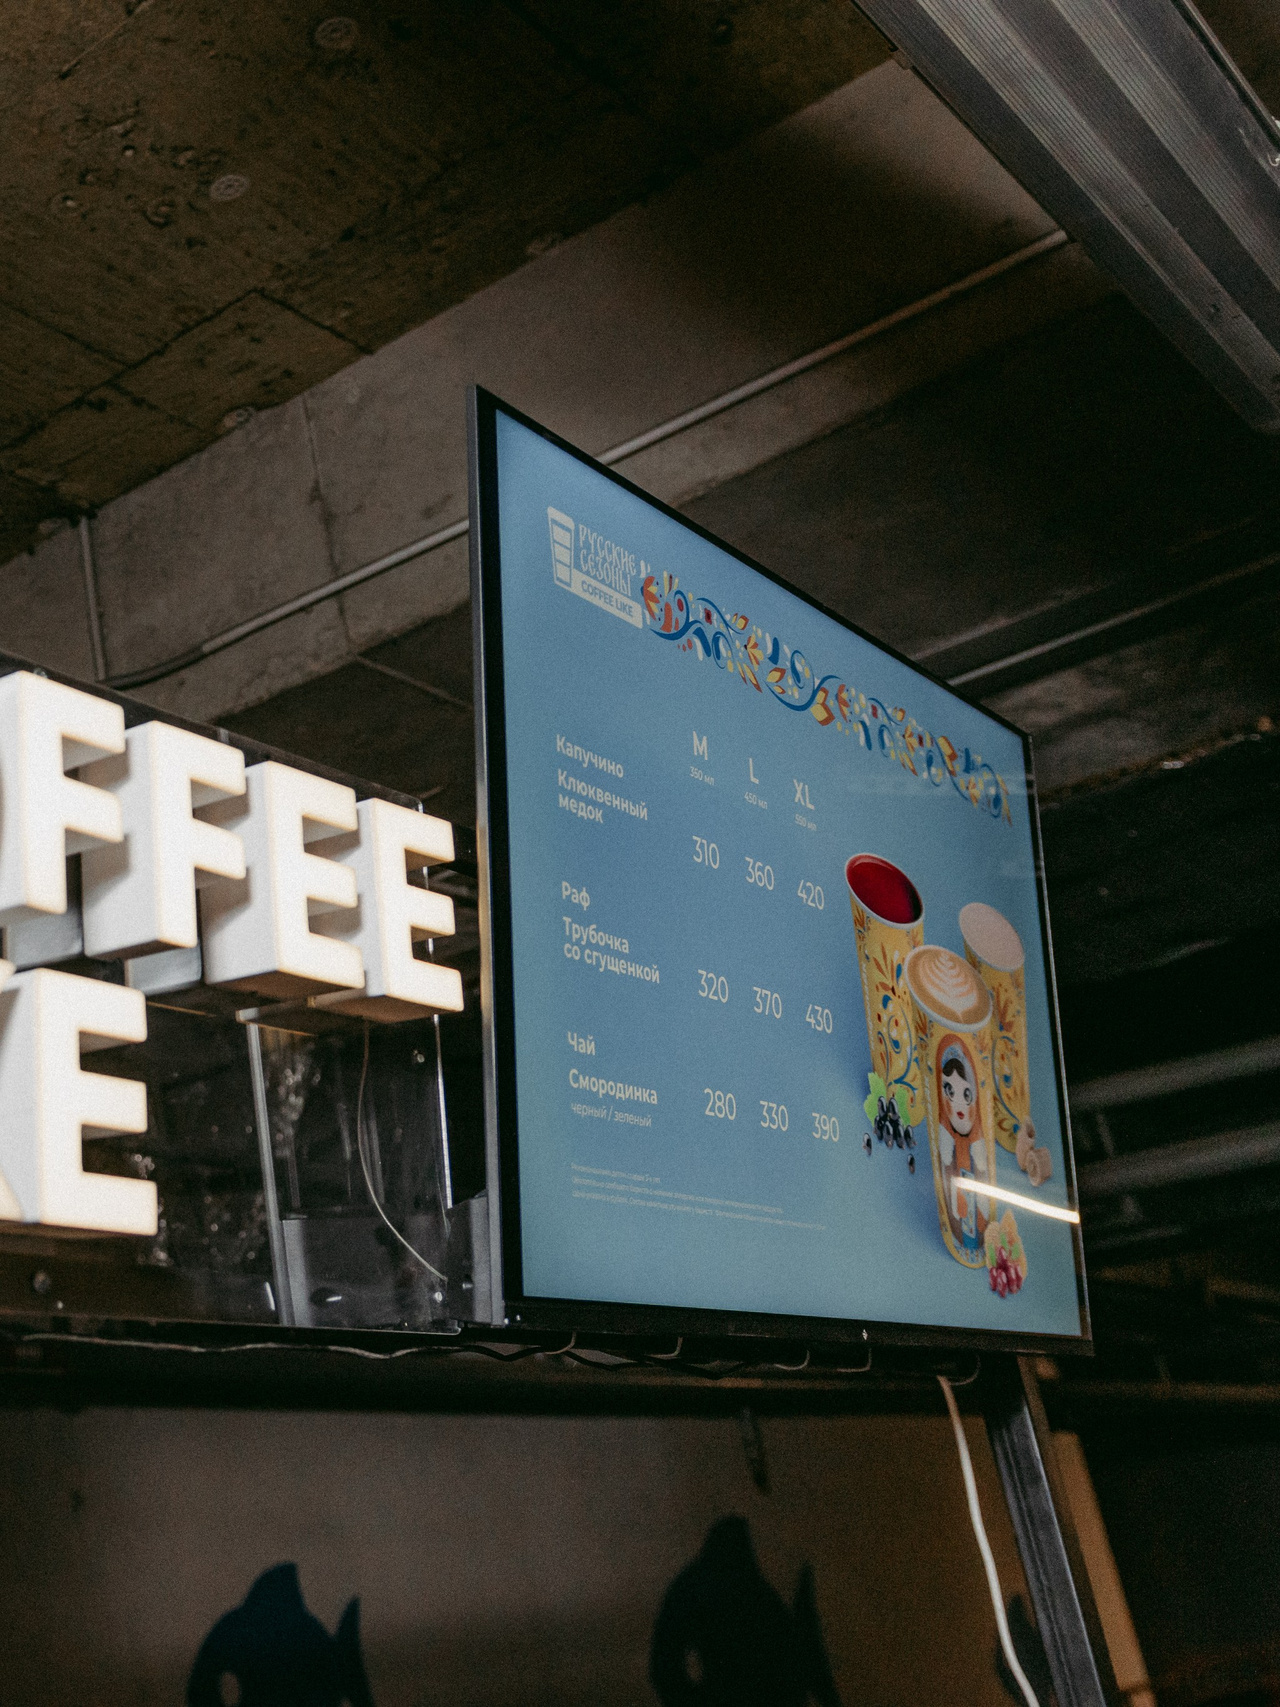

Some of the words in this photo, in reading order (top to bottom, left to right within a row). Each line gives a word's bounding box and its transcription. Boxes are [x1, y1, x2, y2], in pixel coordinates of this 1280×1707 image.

[581, 579, 614, 608] COFFEE
[615, 597, 634, 618] LIKE
[556, 734, 624, 778] Капучино
[692, 730, 709, 761] M
[748, 757, 760, 785] L
[557, 768, 648, 821] Клюквенный
[558, 794, 603, 824] медок
[793, 779, 815, 810] XL
[692, 835, 720, 870] 310
[745, 856, 775, 891] 360
[561, 881, 591, 911] Раф
[797, 879, 825, 910] 420
[562, 916, 629, 954] Трубочка
[563, 943, 581, 961] со
[583, 947, 660, 984] сгущенкой
[697, 969, 729, 1004] 320
[752, 986, 782, 1019] 370
[805, 1004, 833, 1034] 430
[567, 1031, 596, 1056] Чай
[569, 1068, 658, 1105] Смородинка
[570, 1102, 608, 1120] черный
[613, 1110, 653, 1127] зеленый
[704, 1088, 737, 1120] 280
[759, 1100, 789, 1132] 330
[811, 1112, 840, 1142] 390
